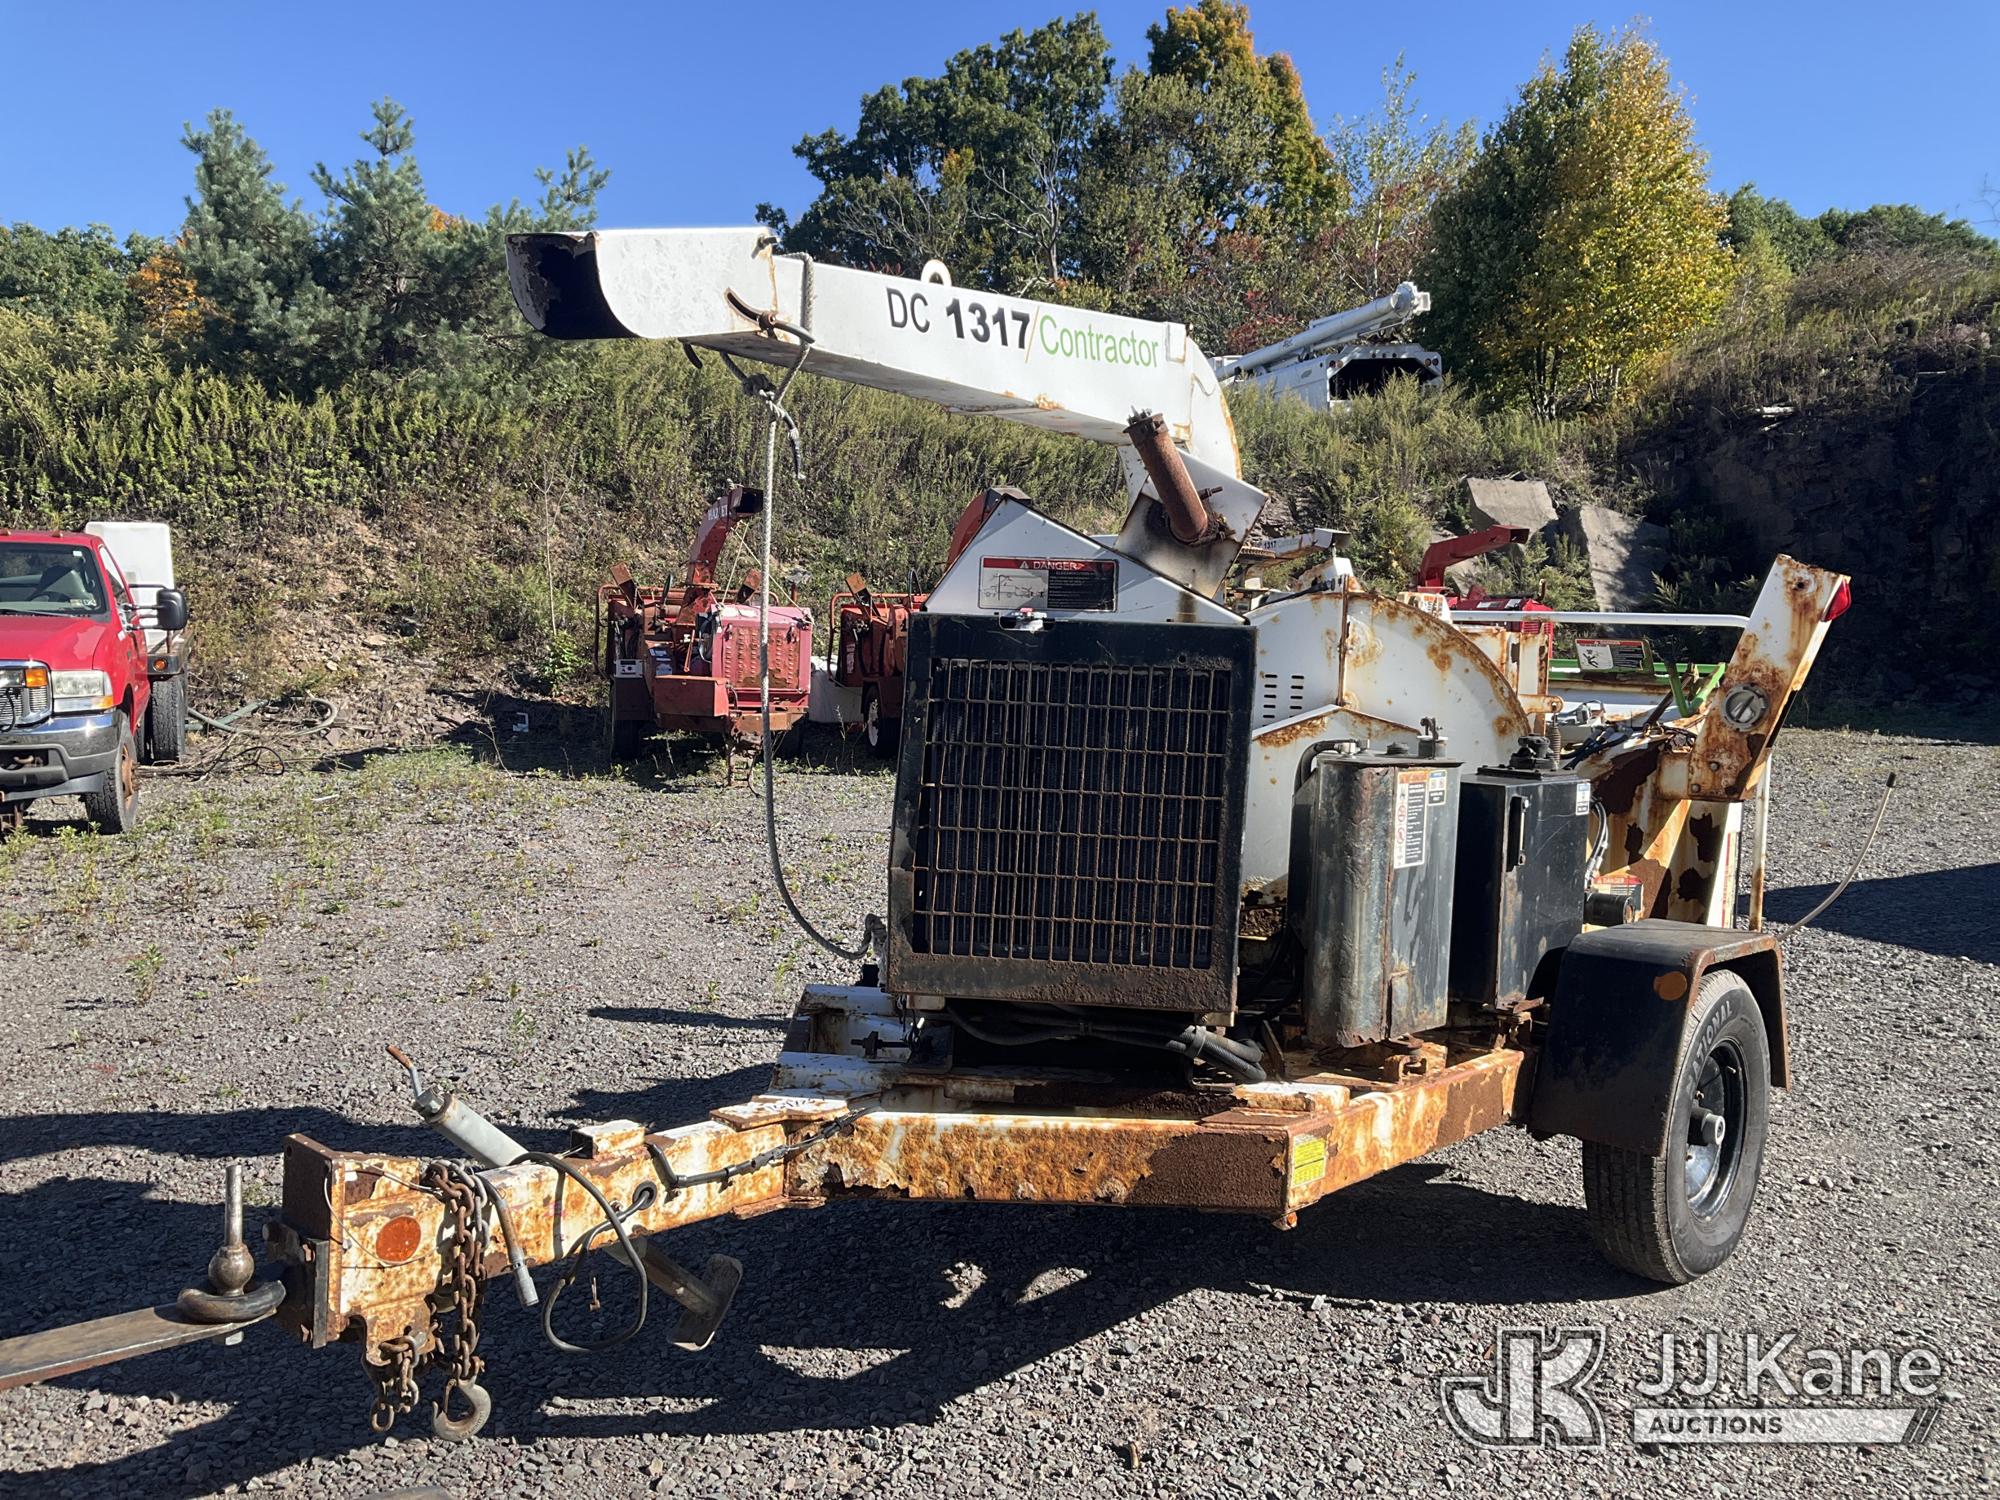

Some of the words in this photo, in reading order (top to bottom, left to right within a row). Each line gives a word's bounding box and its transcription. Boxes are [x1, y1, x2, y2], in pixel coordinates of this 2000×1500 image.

[886, 287, 931, 334] DC
[945, 298, 1030, 349] 1317
[1039, 315, 1159, 368] Contractor
[1033, 561, 1078, 571] DANGER
